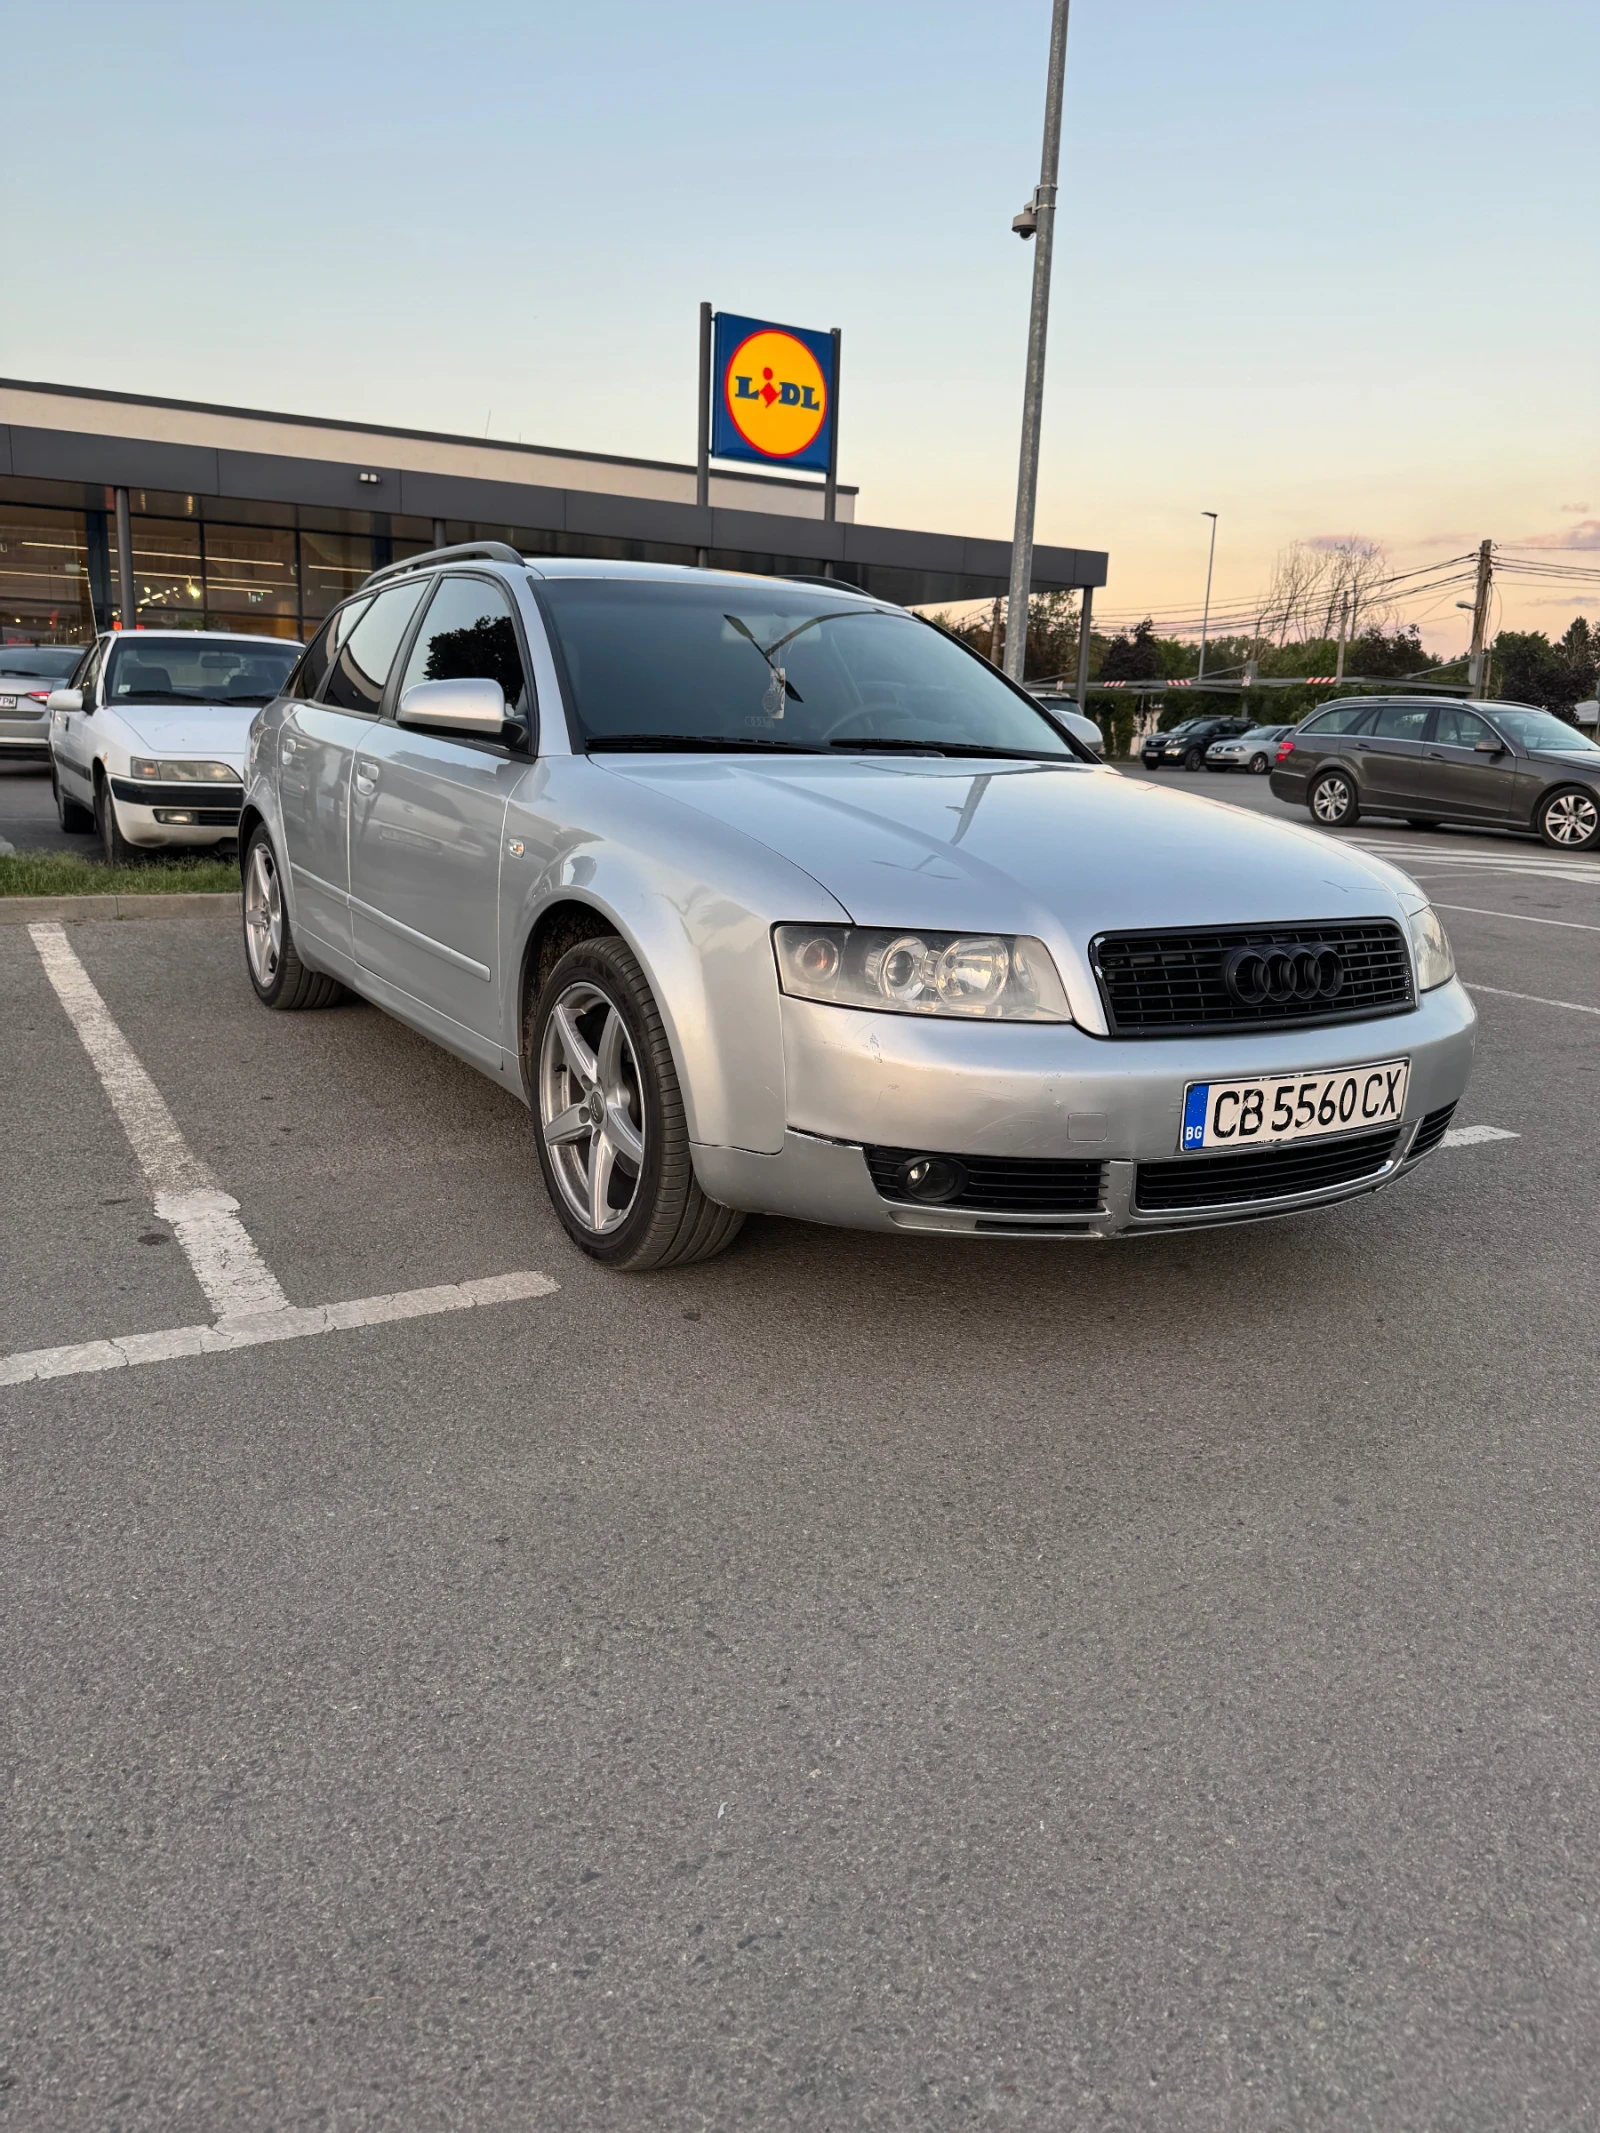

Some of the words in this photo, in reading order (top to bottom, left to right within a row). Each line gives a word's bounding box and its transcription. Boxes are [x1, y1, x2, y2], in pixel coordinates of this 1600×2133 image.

[1213, 1088, 1264, 1138] CB
[1271, 1077, 1357, 1132] 5560
[1362, 1069, 1402, 1119] CX
[1185, 1125, 1203, 1140] BG
